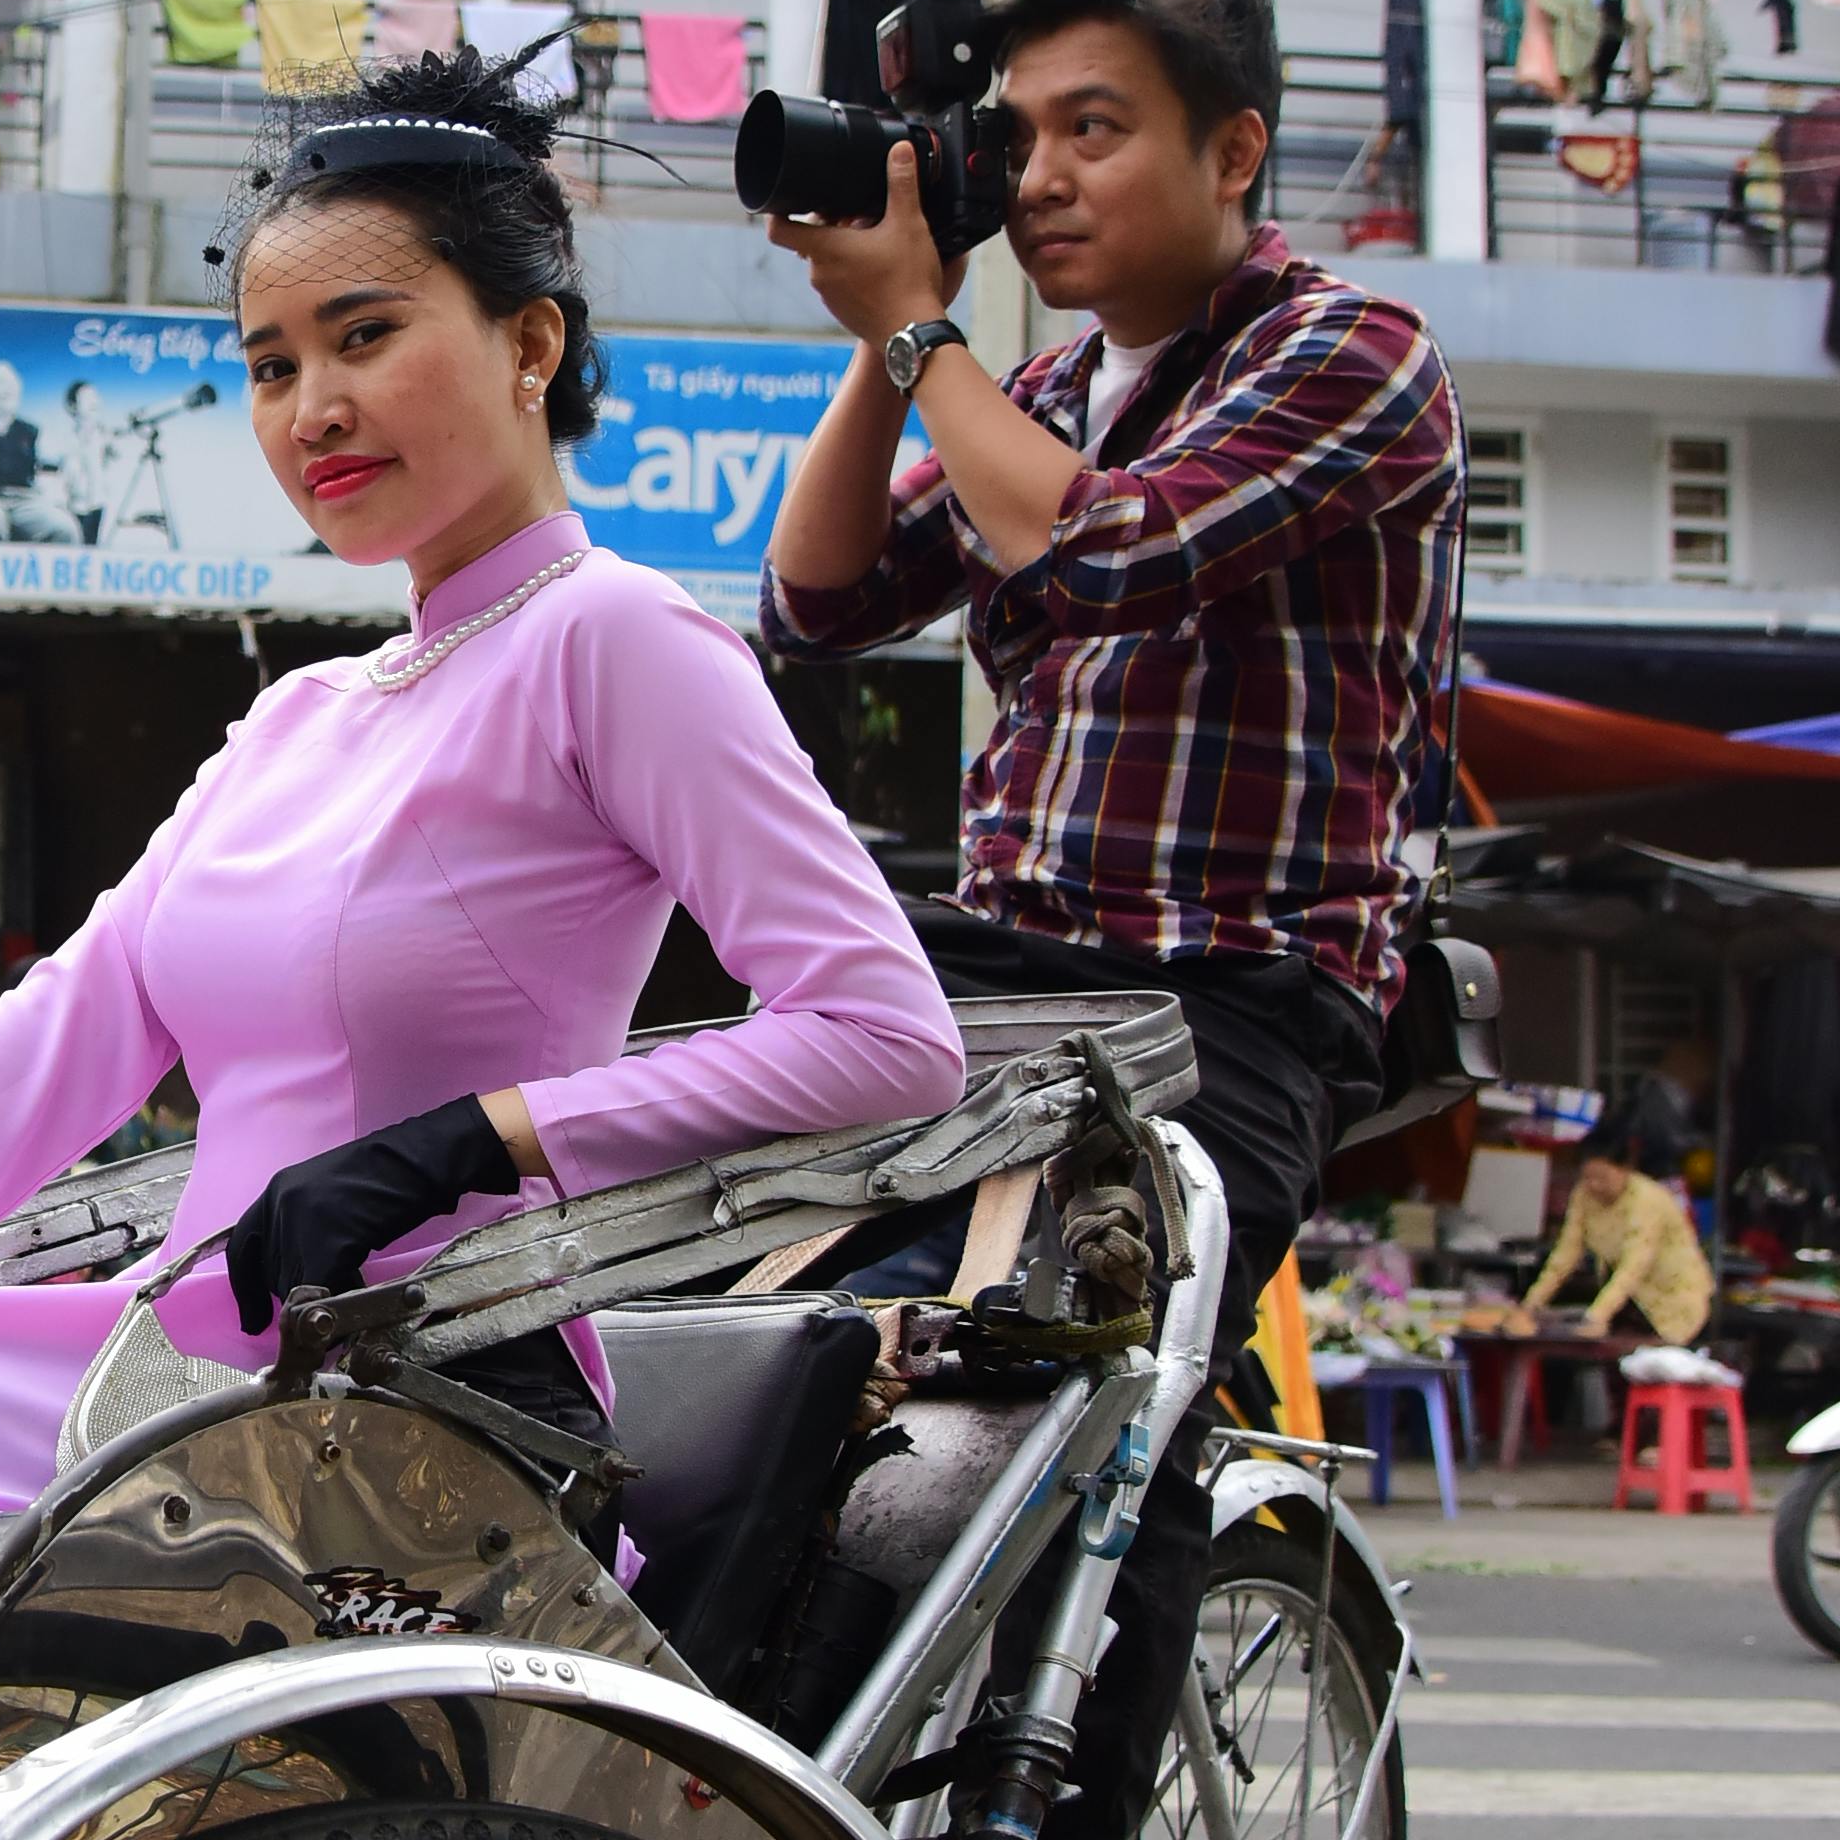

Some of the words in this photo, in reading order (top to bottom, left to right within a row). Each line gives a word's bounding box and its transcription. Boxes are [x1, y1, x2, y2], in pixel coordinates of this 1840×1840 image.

[2, 551, 41, 591] VÀ
[53, 554, 91, 593] BÉ
[101, 561, 188, 604] NGỌC
[198, 558, 272, 601] DIỆP
